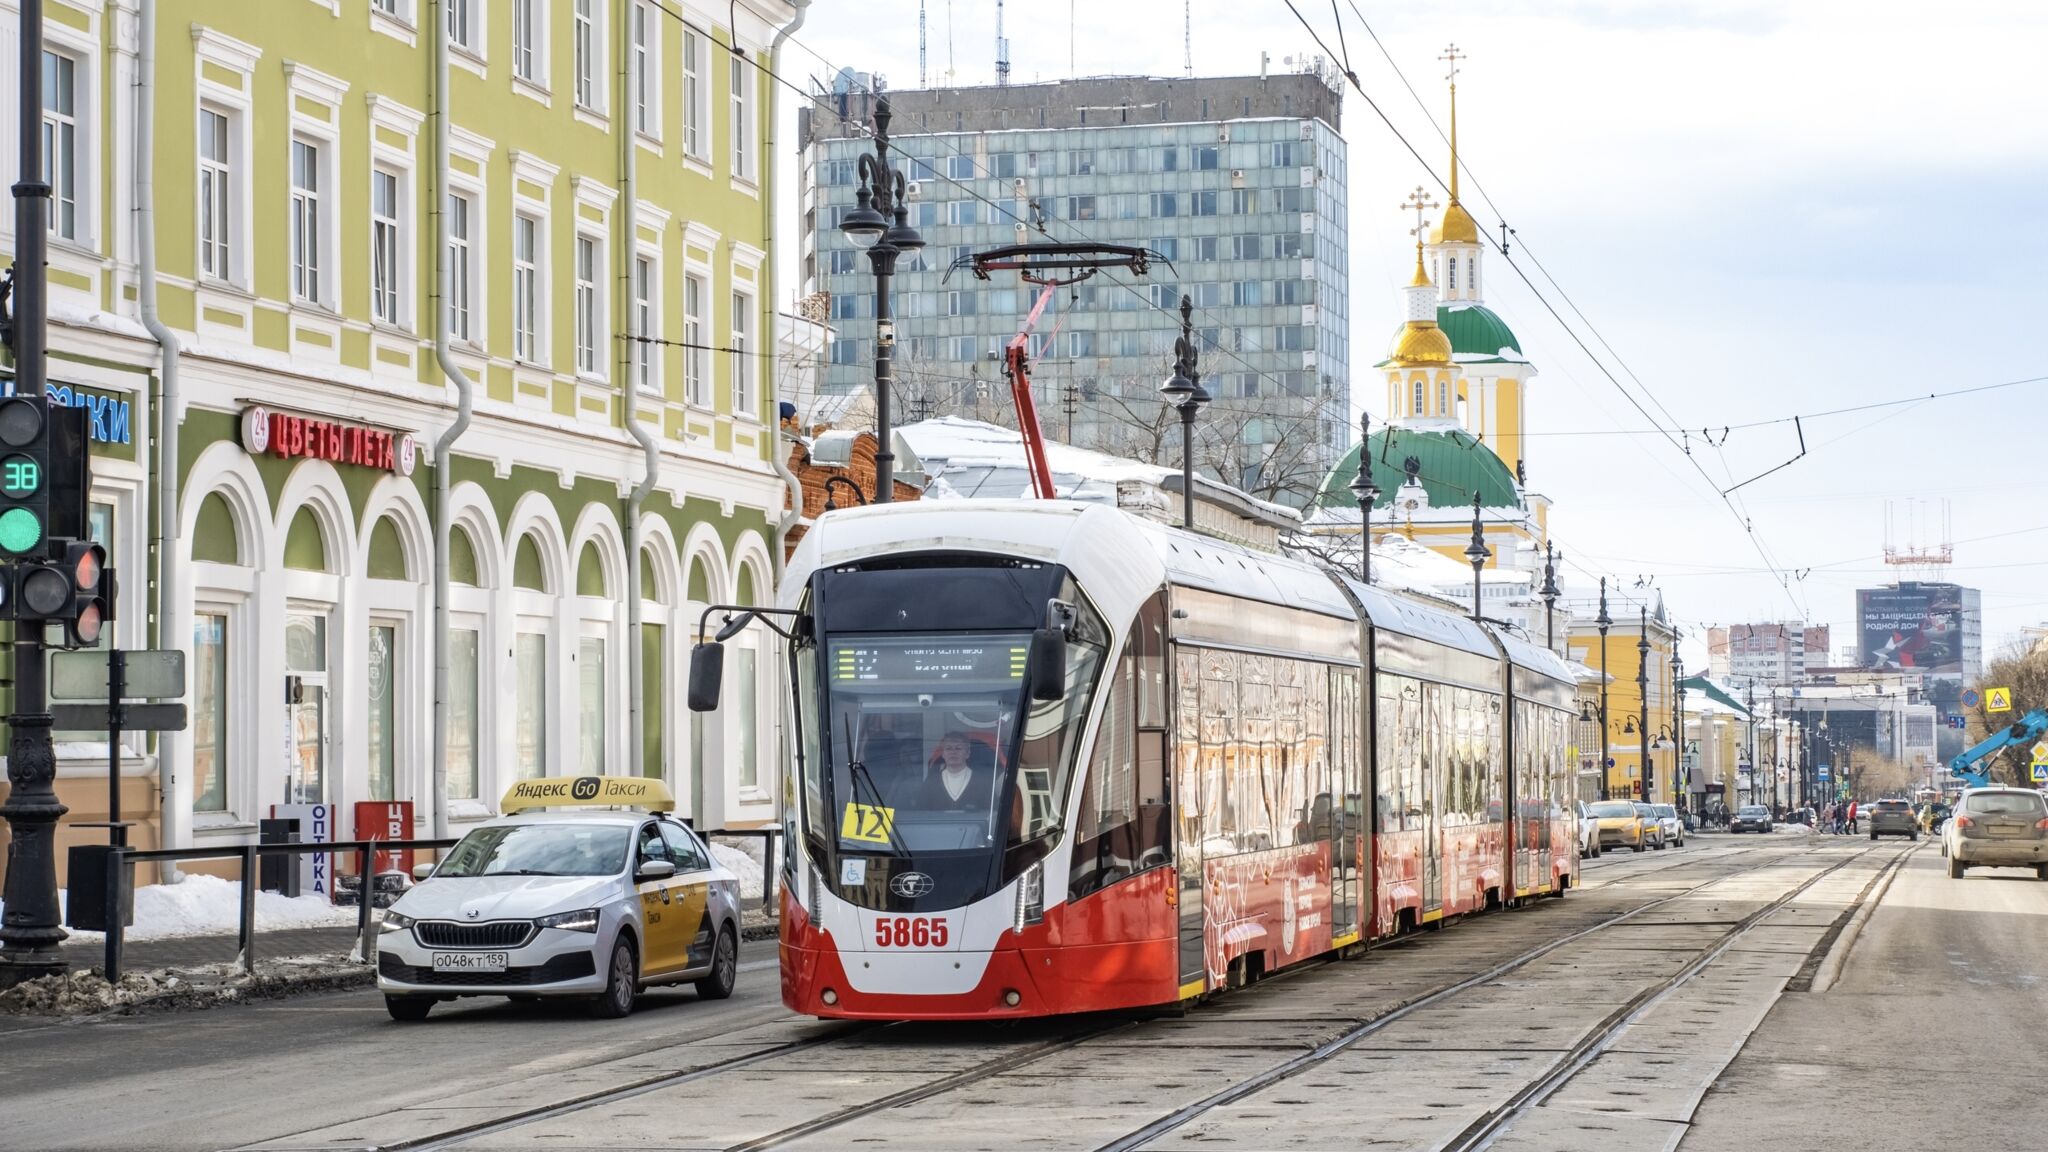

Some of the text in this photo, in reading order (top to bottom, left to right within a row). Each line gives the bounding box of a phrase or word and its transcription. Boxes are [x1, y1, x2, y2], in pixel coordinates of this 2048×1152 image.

[255, 410, 265, 436] 24
[275, 413, 395, 470] ЦВЕТЫ ЛЕТА
[404, 438, 413, 461] 24
[5, 463, 38, 490] 38
[1865, 613, 1879, 621] МЫ
[1865, 620, 1919, 631] РОДНОЙ ДОМ
[515, 782, 568, 798] Яндекс
[574, 779, 596, 796] Go
[604, 779, 646, 796] Такси
[854, 808, 884, 838] 12
[312, 805, 326, 894] ОПТИКА
[875, 917, 949, 947] 5865
[485, 953, 504, 965] 159
